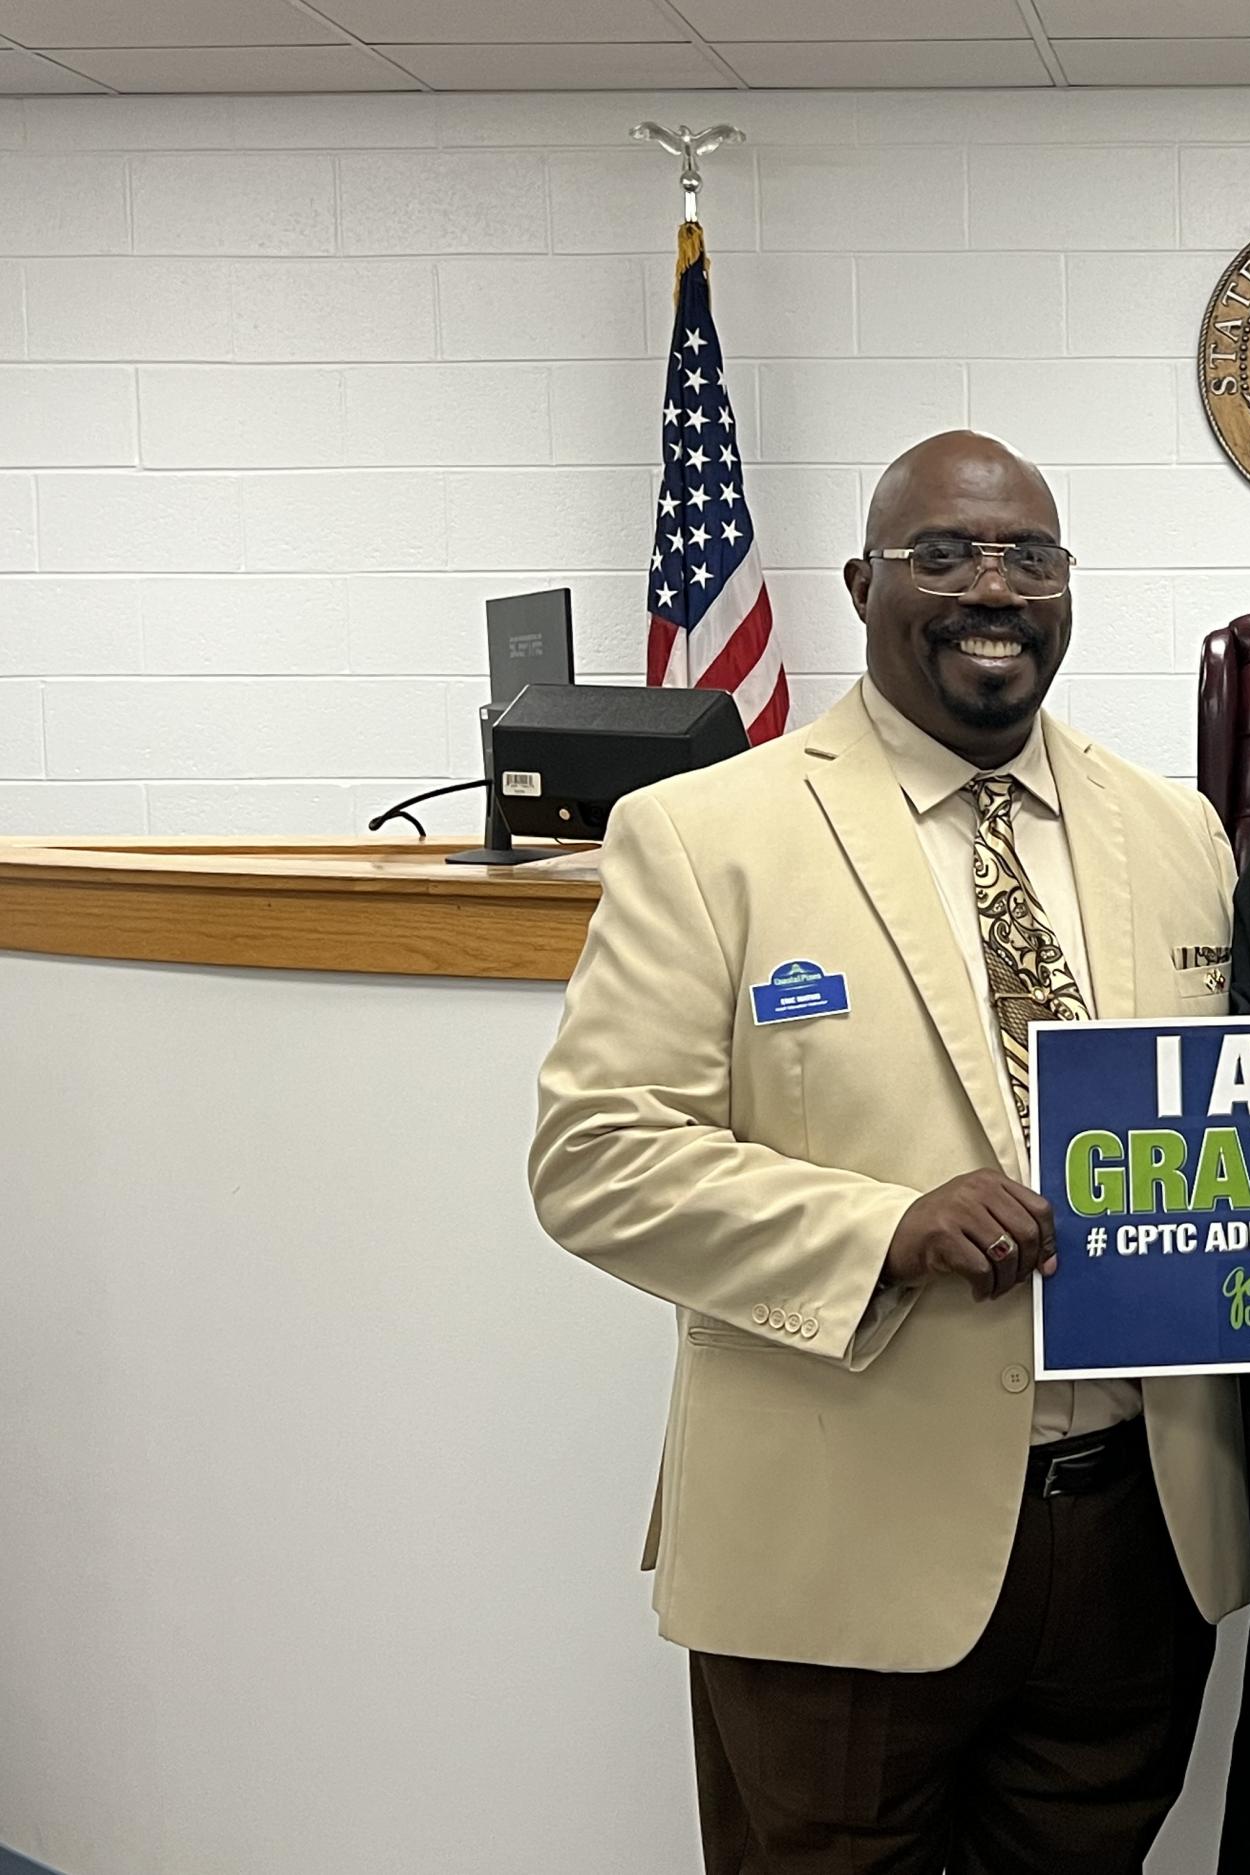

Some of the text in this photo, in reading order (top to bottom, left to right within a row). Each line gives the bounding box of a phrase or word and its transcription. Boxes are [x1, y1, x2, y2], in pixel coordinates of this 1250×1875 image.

[1156, 1035, 1182, 1118] I
[1086, 1227, 1108, 1257] #
[1116, 1223, 1198, 1256] CPTC
